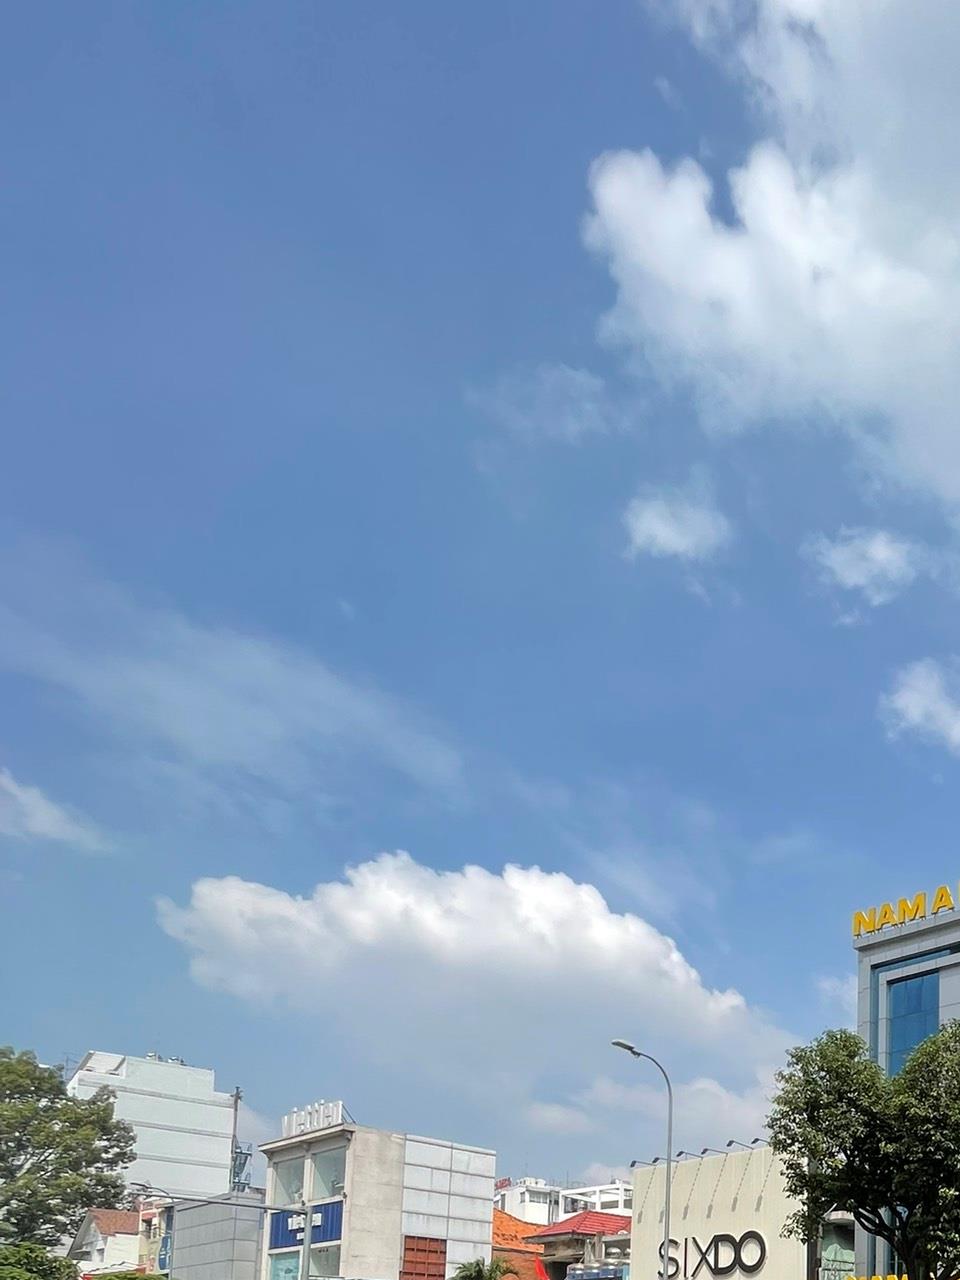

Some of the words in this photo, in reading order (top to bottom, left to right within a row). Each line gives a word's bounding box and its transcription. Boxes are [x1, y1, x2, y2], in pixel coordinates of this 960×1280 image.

[853, 892, 927, 937] NAM
[931, 885, 955, 915] A
[658, 1230, 767, 1280] SIXDO
